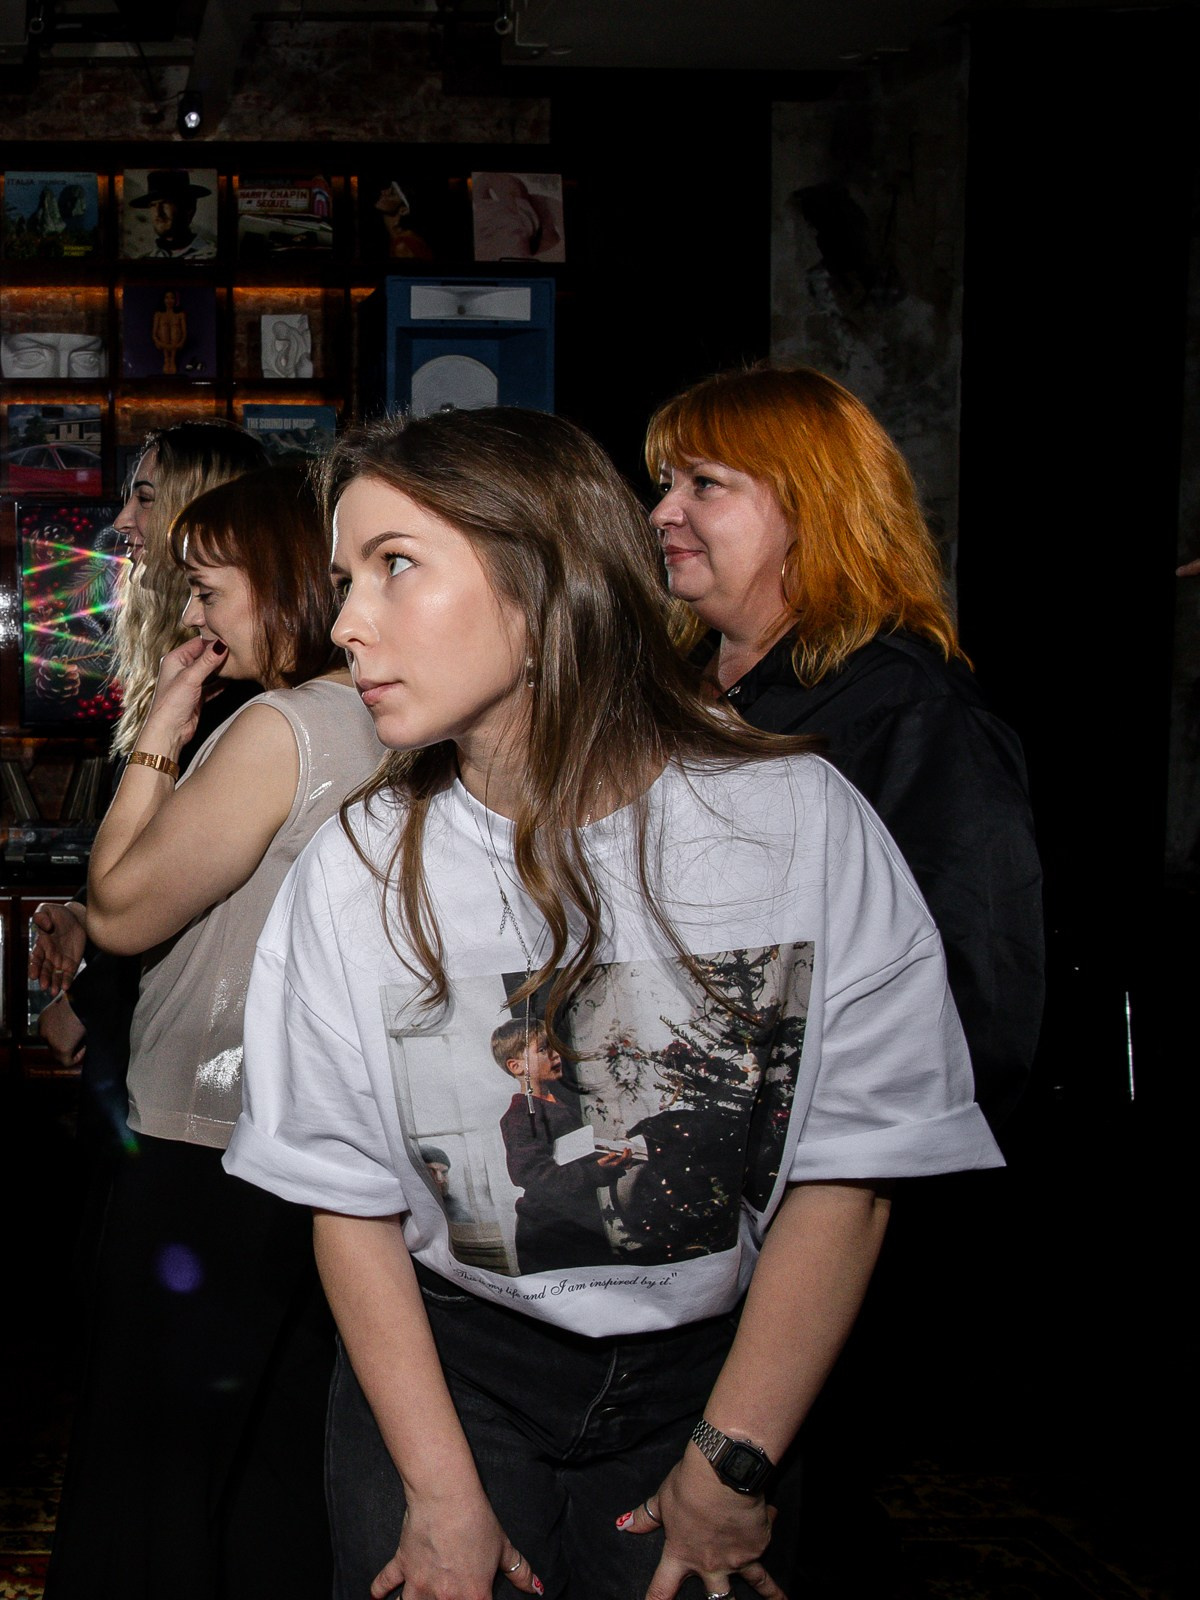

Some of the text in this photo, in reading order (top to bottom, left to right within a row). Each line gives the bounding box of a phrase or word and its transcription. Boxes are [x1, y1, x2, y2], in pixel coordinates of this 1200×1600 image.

[239, 190, 307, 199] HARRY CHAPIN
[256, 199, 291, 208] SEQUEL
[486, 1283, 503, 1294] my
[505, 1286, 521, 1298] life
[523, 1285, 547, 1300] and
[550, 1278, 569, 1296] I
[567, 1282, 587, 1293] am
[589, 1276, 638, 1290] inspired
[640, 1276, 656, 1289] by
